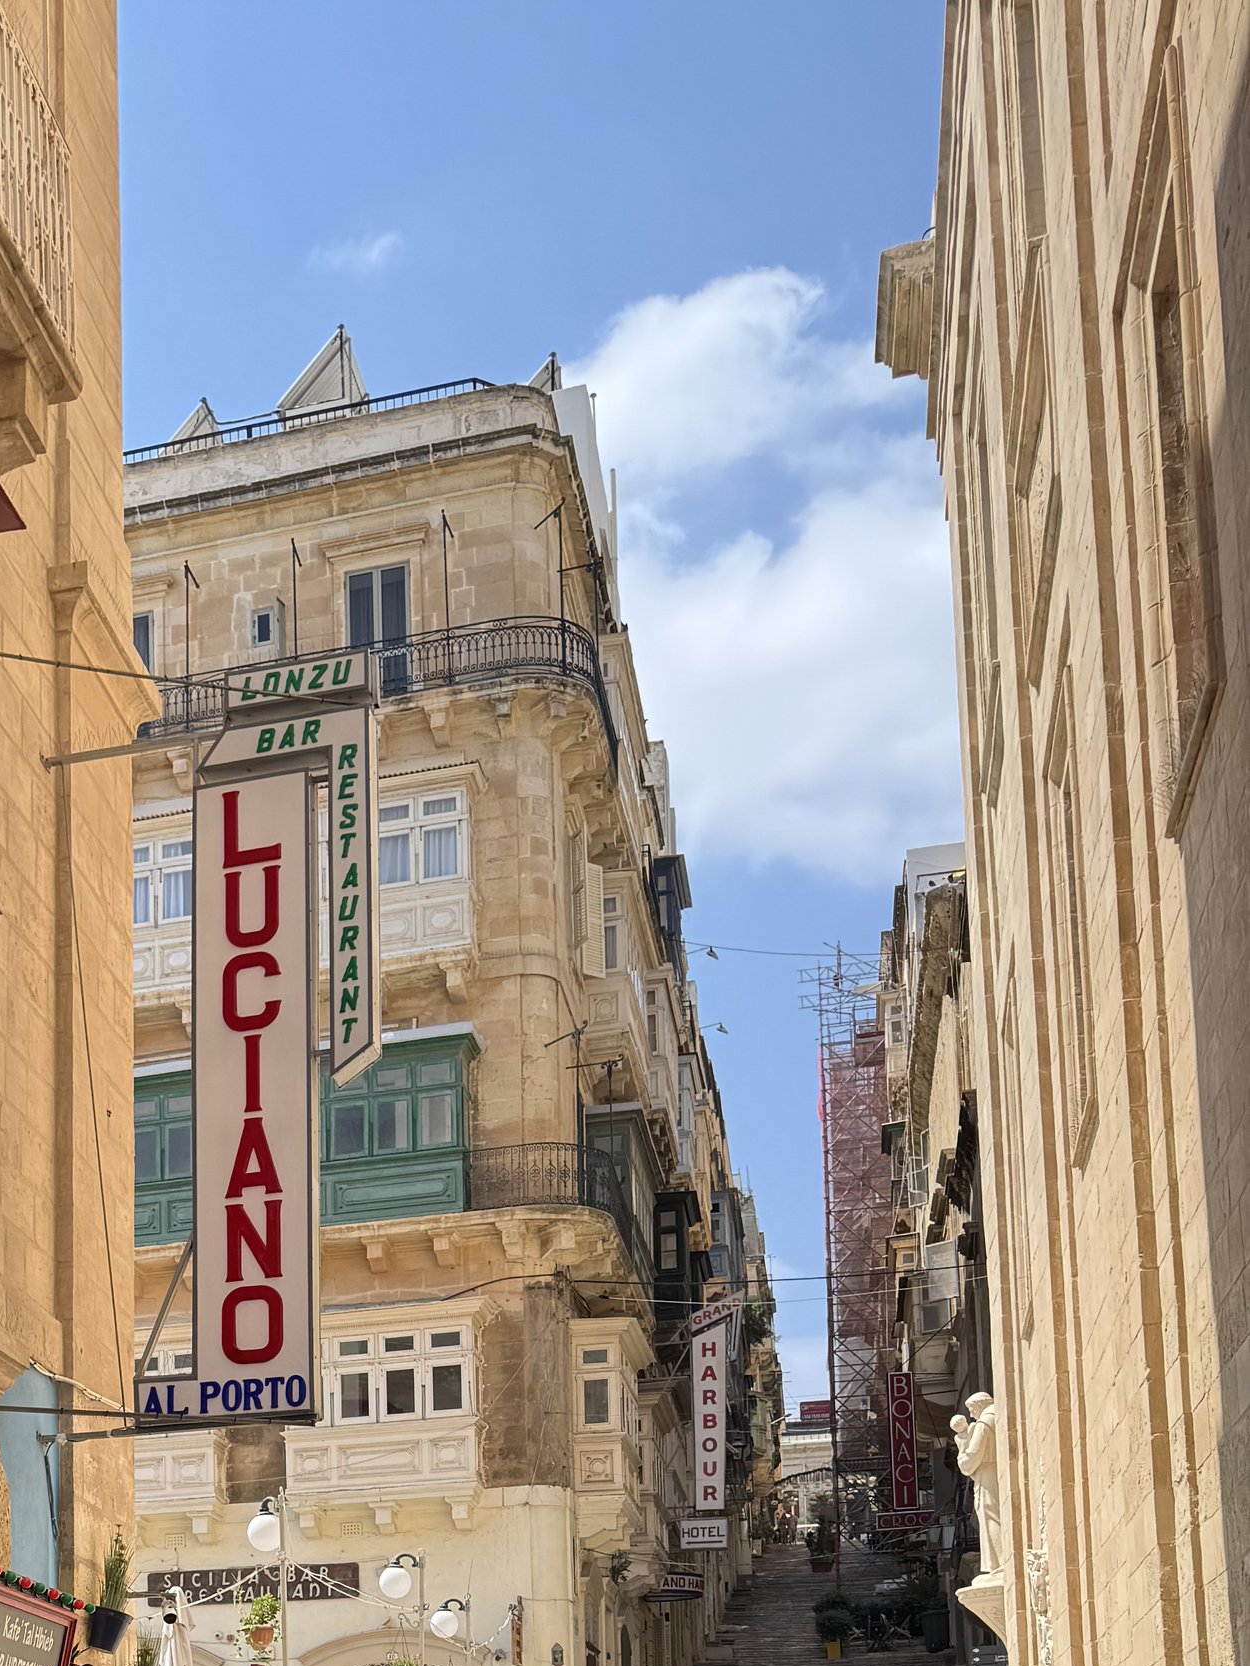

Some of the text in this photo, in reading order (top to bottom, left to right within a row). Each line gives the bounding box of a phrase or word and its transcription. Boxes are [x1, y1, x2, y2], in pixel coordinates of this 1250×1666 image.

[241, 659, 352, 701] LONZU
[256, 719, 321, 753] BAR
[337, 744, 359, 1044] RESTAURANT
[222, 789, 284, 1365] LUCIANO
[693, 1298, 741, 1325] GRAND
[144, 1374, 307, 1415] AL PORTO
[700, 1342, 718, 1501] HARBOUR
[892, 1376, 915, 1505] BONACI
[682, 1525, 726, 1539] HOTEL
[163, 1564, 330, 1588] SICILIA BAR
[184, 1582, 335, 1602] RESAUANT
[22, 1622, 35, 1646] Tal
